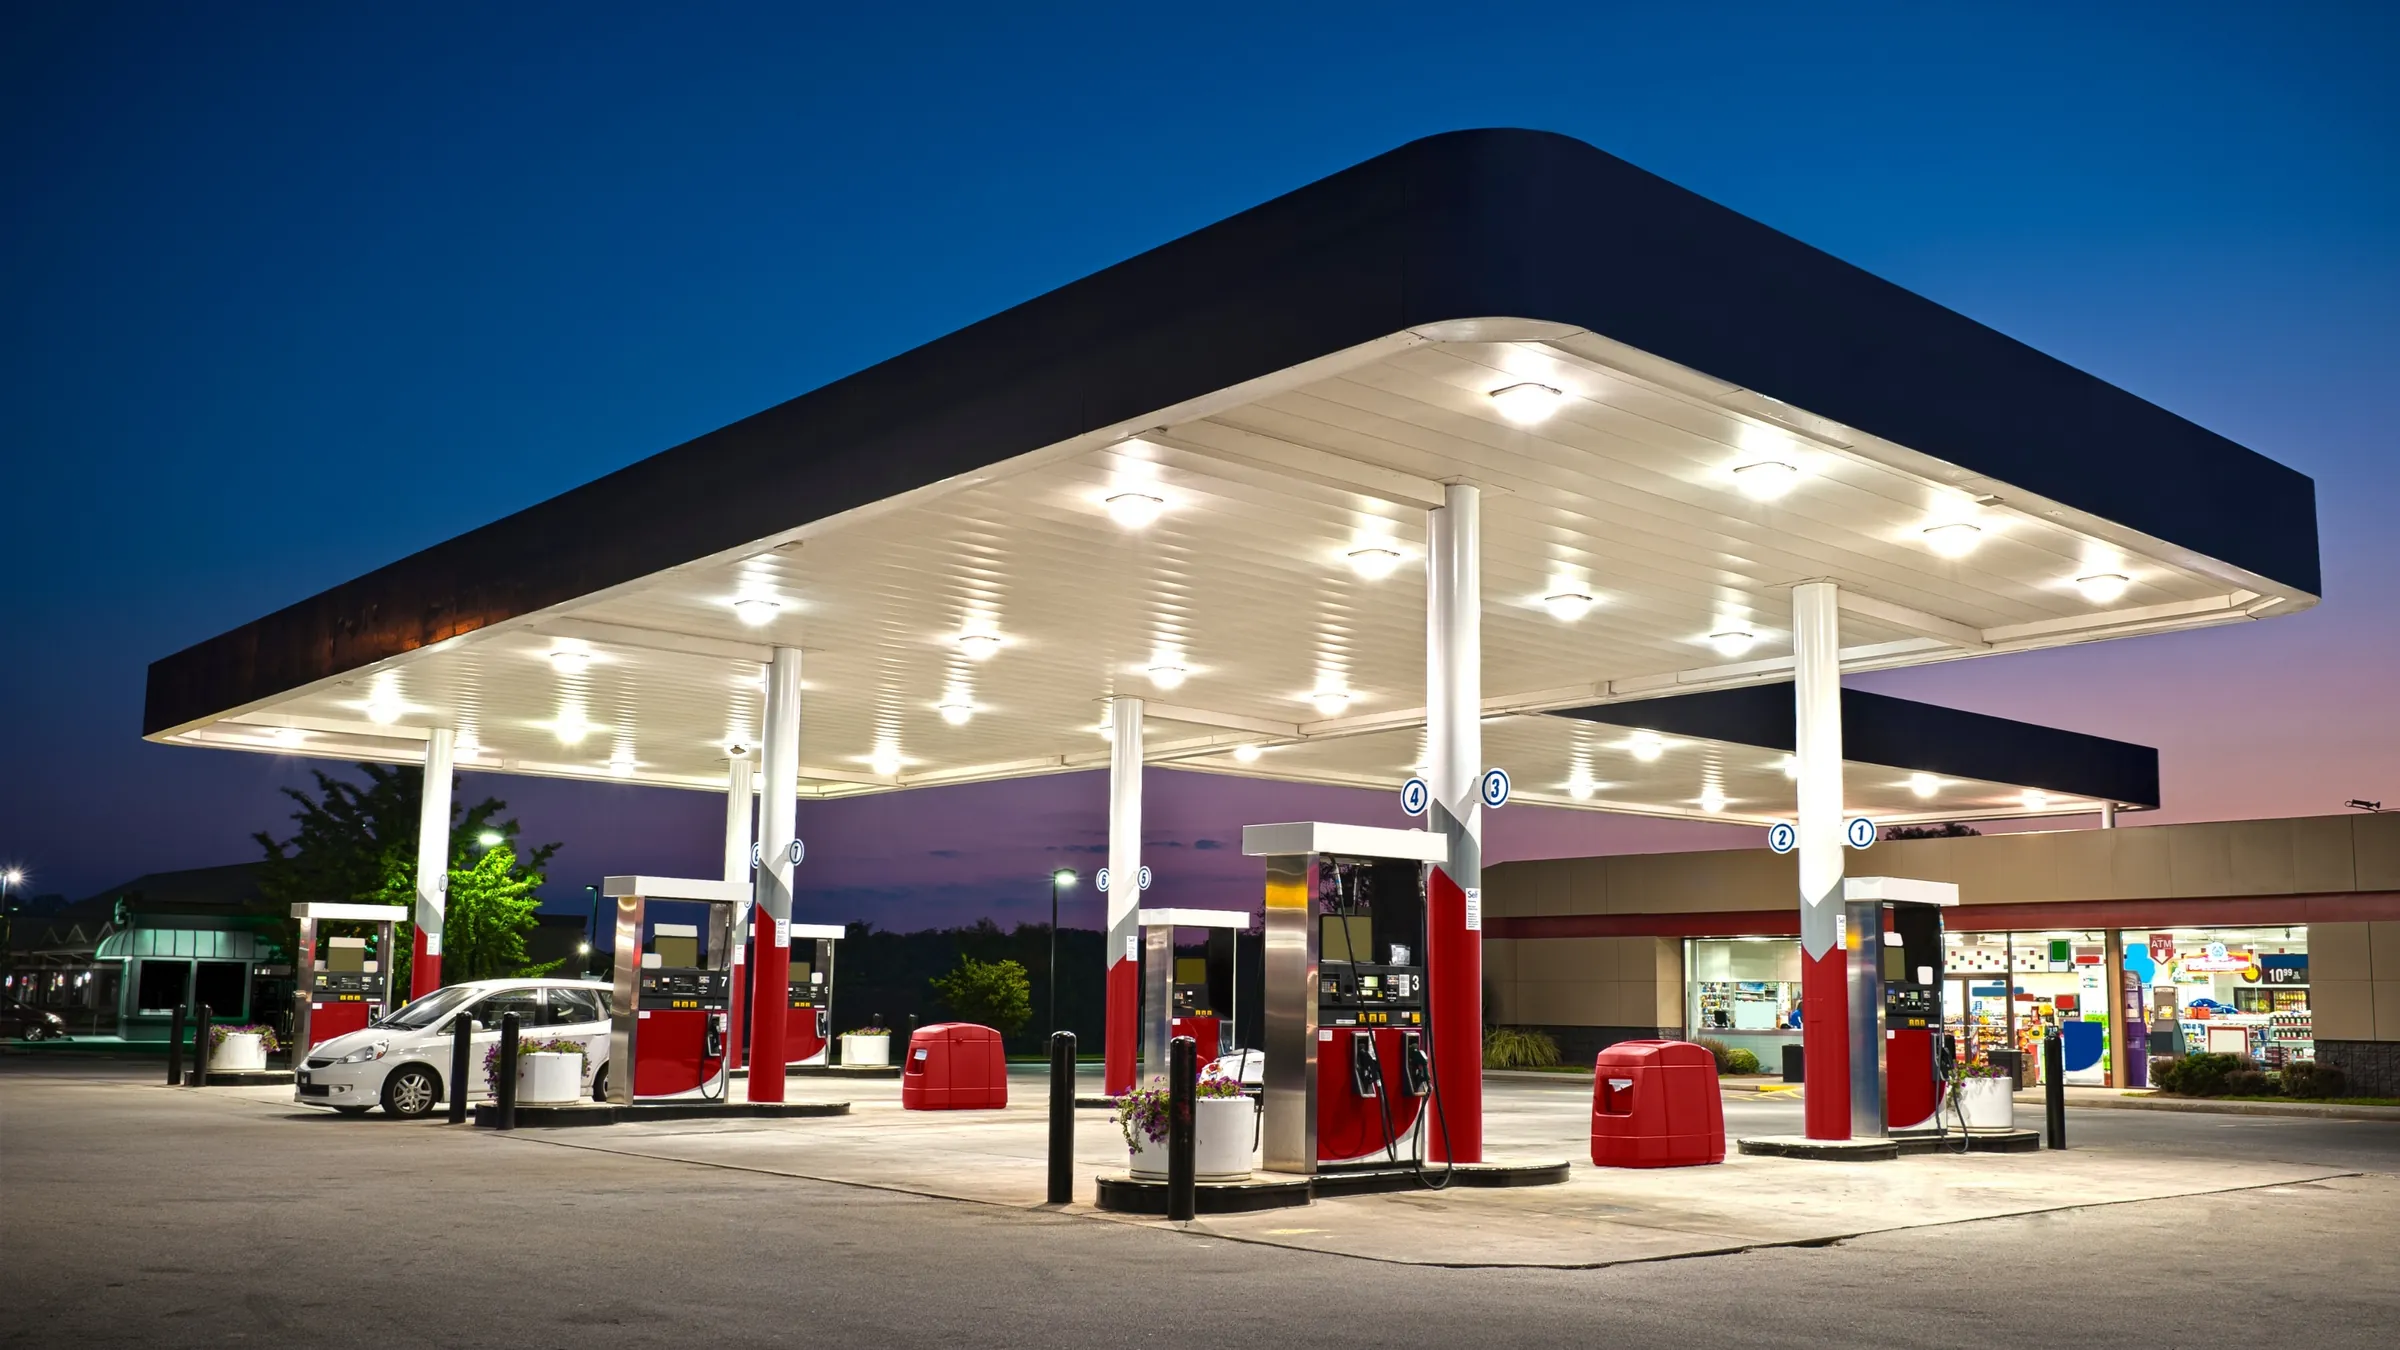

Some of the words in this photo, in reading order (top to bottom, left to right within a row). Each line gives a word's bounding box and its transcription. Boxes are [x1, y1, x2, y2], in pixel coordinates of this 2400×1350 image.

[1491, 779, 1500, 798] 3
[1410, 787, 1419, 806] 4
[1778, 830, 1787, 845] 2
[1858, 825, 1864, 841] 1
[794, 846, 799, 859] 7
[1102, 874, 1107, 886] 6
[1142, 873, 1147, 884] 5
[2151, 940, 2172, 948] ATM
[721, 976, 728, 988] 7
[1412, 975, 1420, 991] 3
